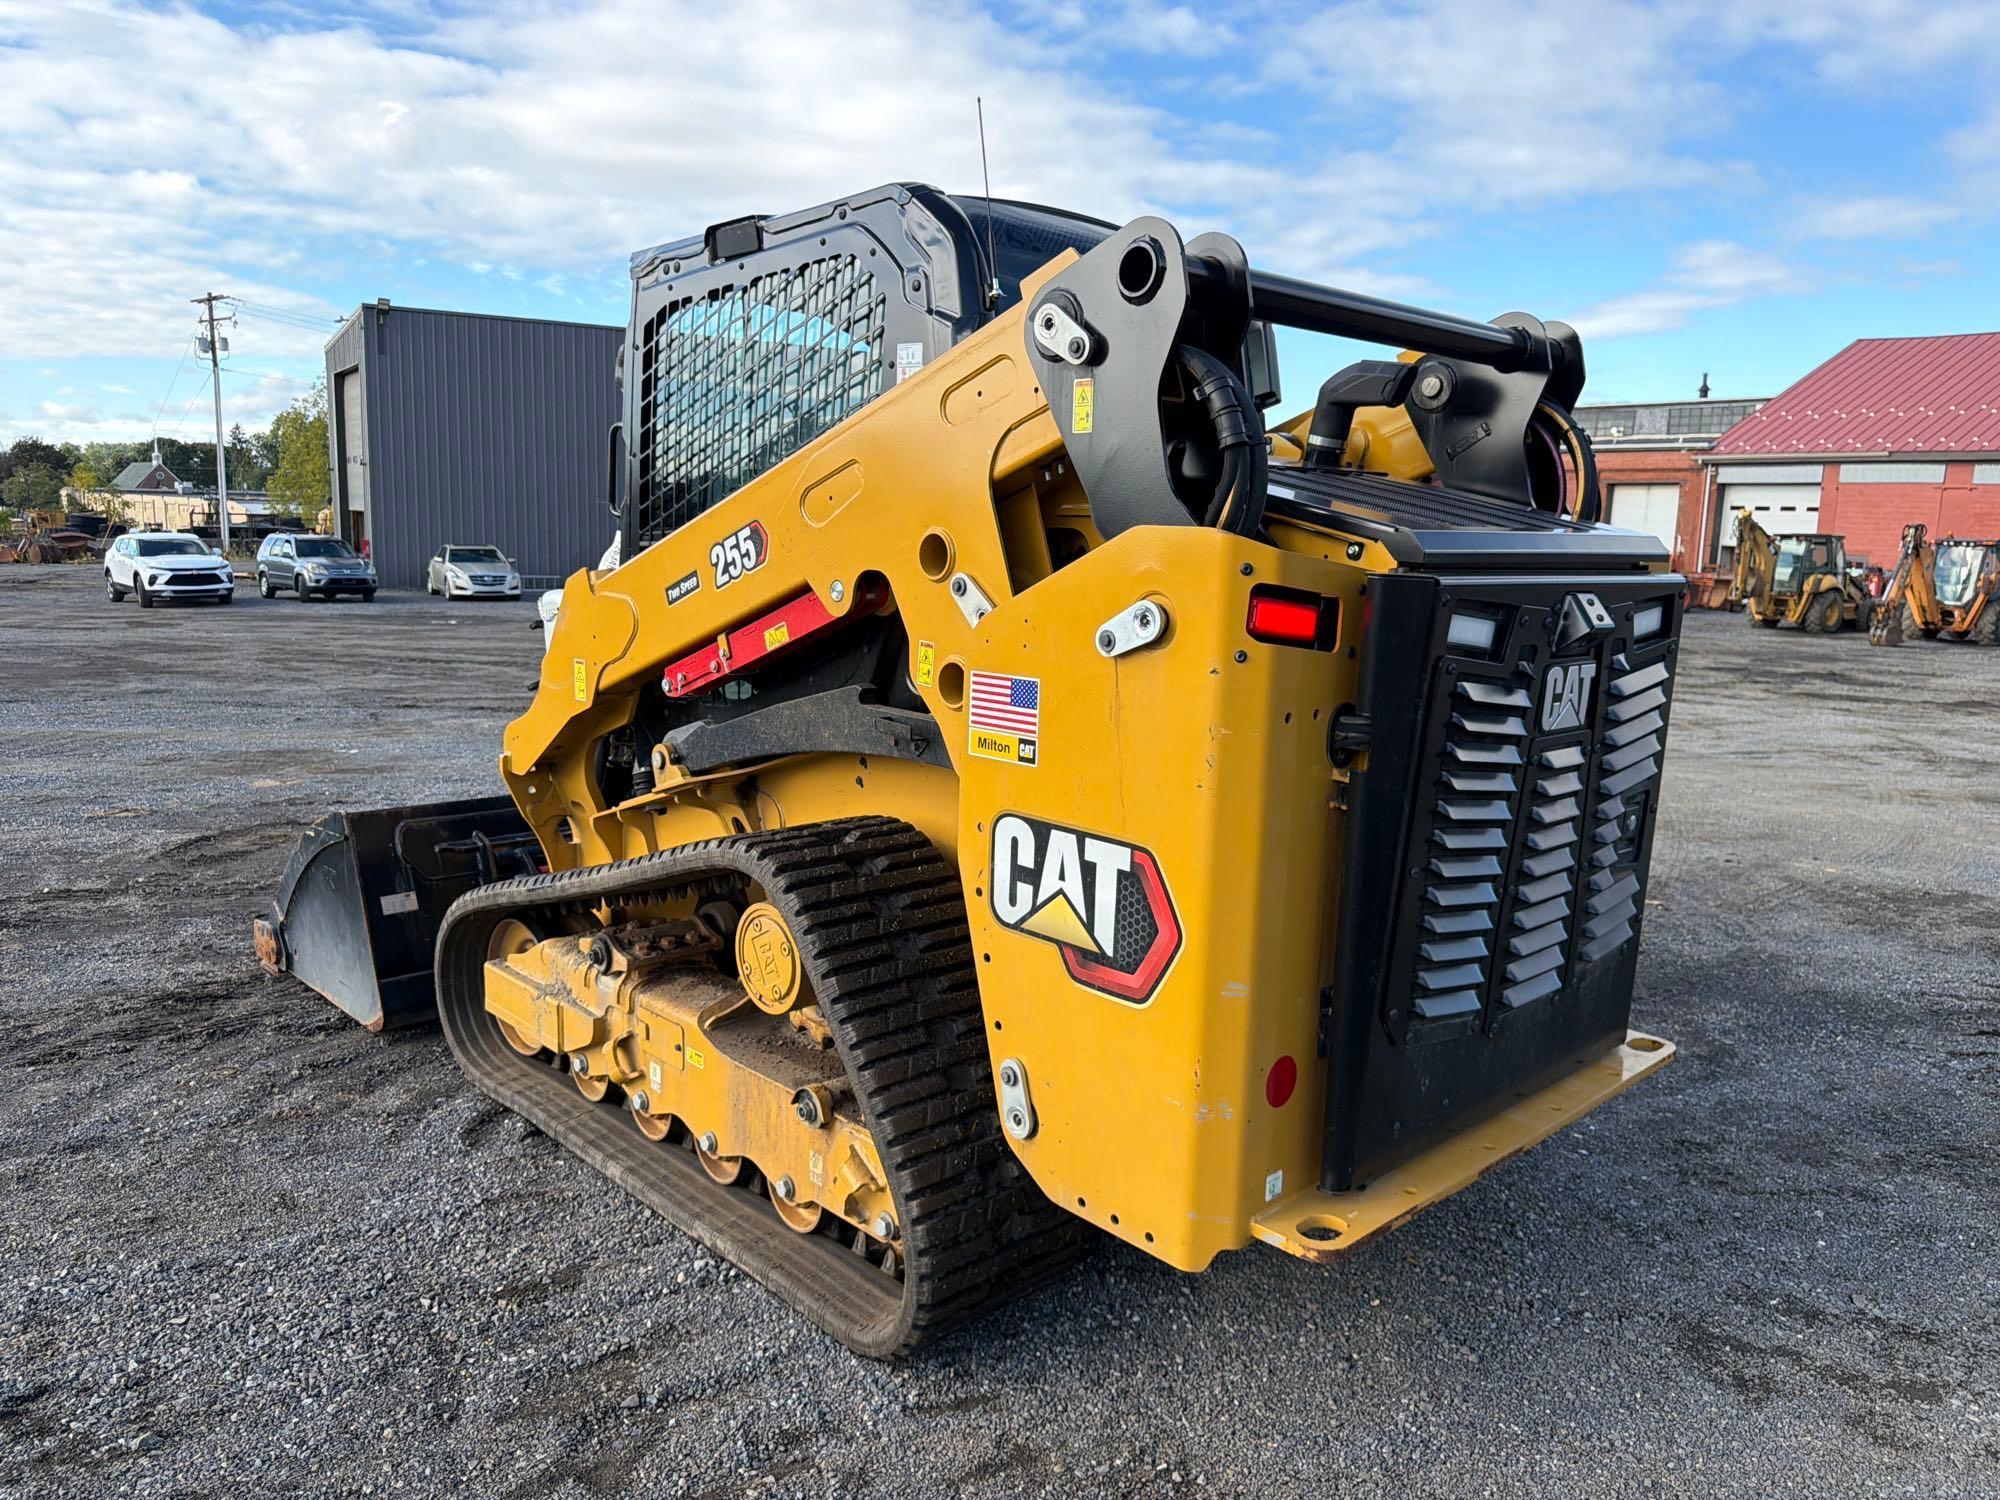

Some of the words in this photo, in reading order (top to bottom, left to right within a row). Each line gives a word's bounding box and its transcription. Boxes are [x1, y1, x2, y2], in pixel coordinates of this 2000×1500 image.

[711, 528, 757, 586] 255
[1542, 664, 1595, 731] CAT
[977, 736, 1011, 754] Milton
[1018, 743, 1035, 759] CAT
[993, 816, 1132, 958] CAT
